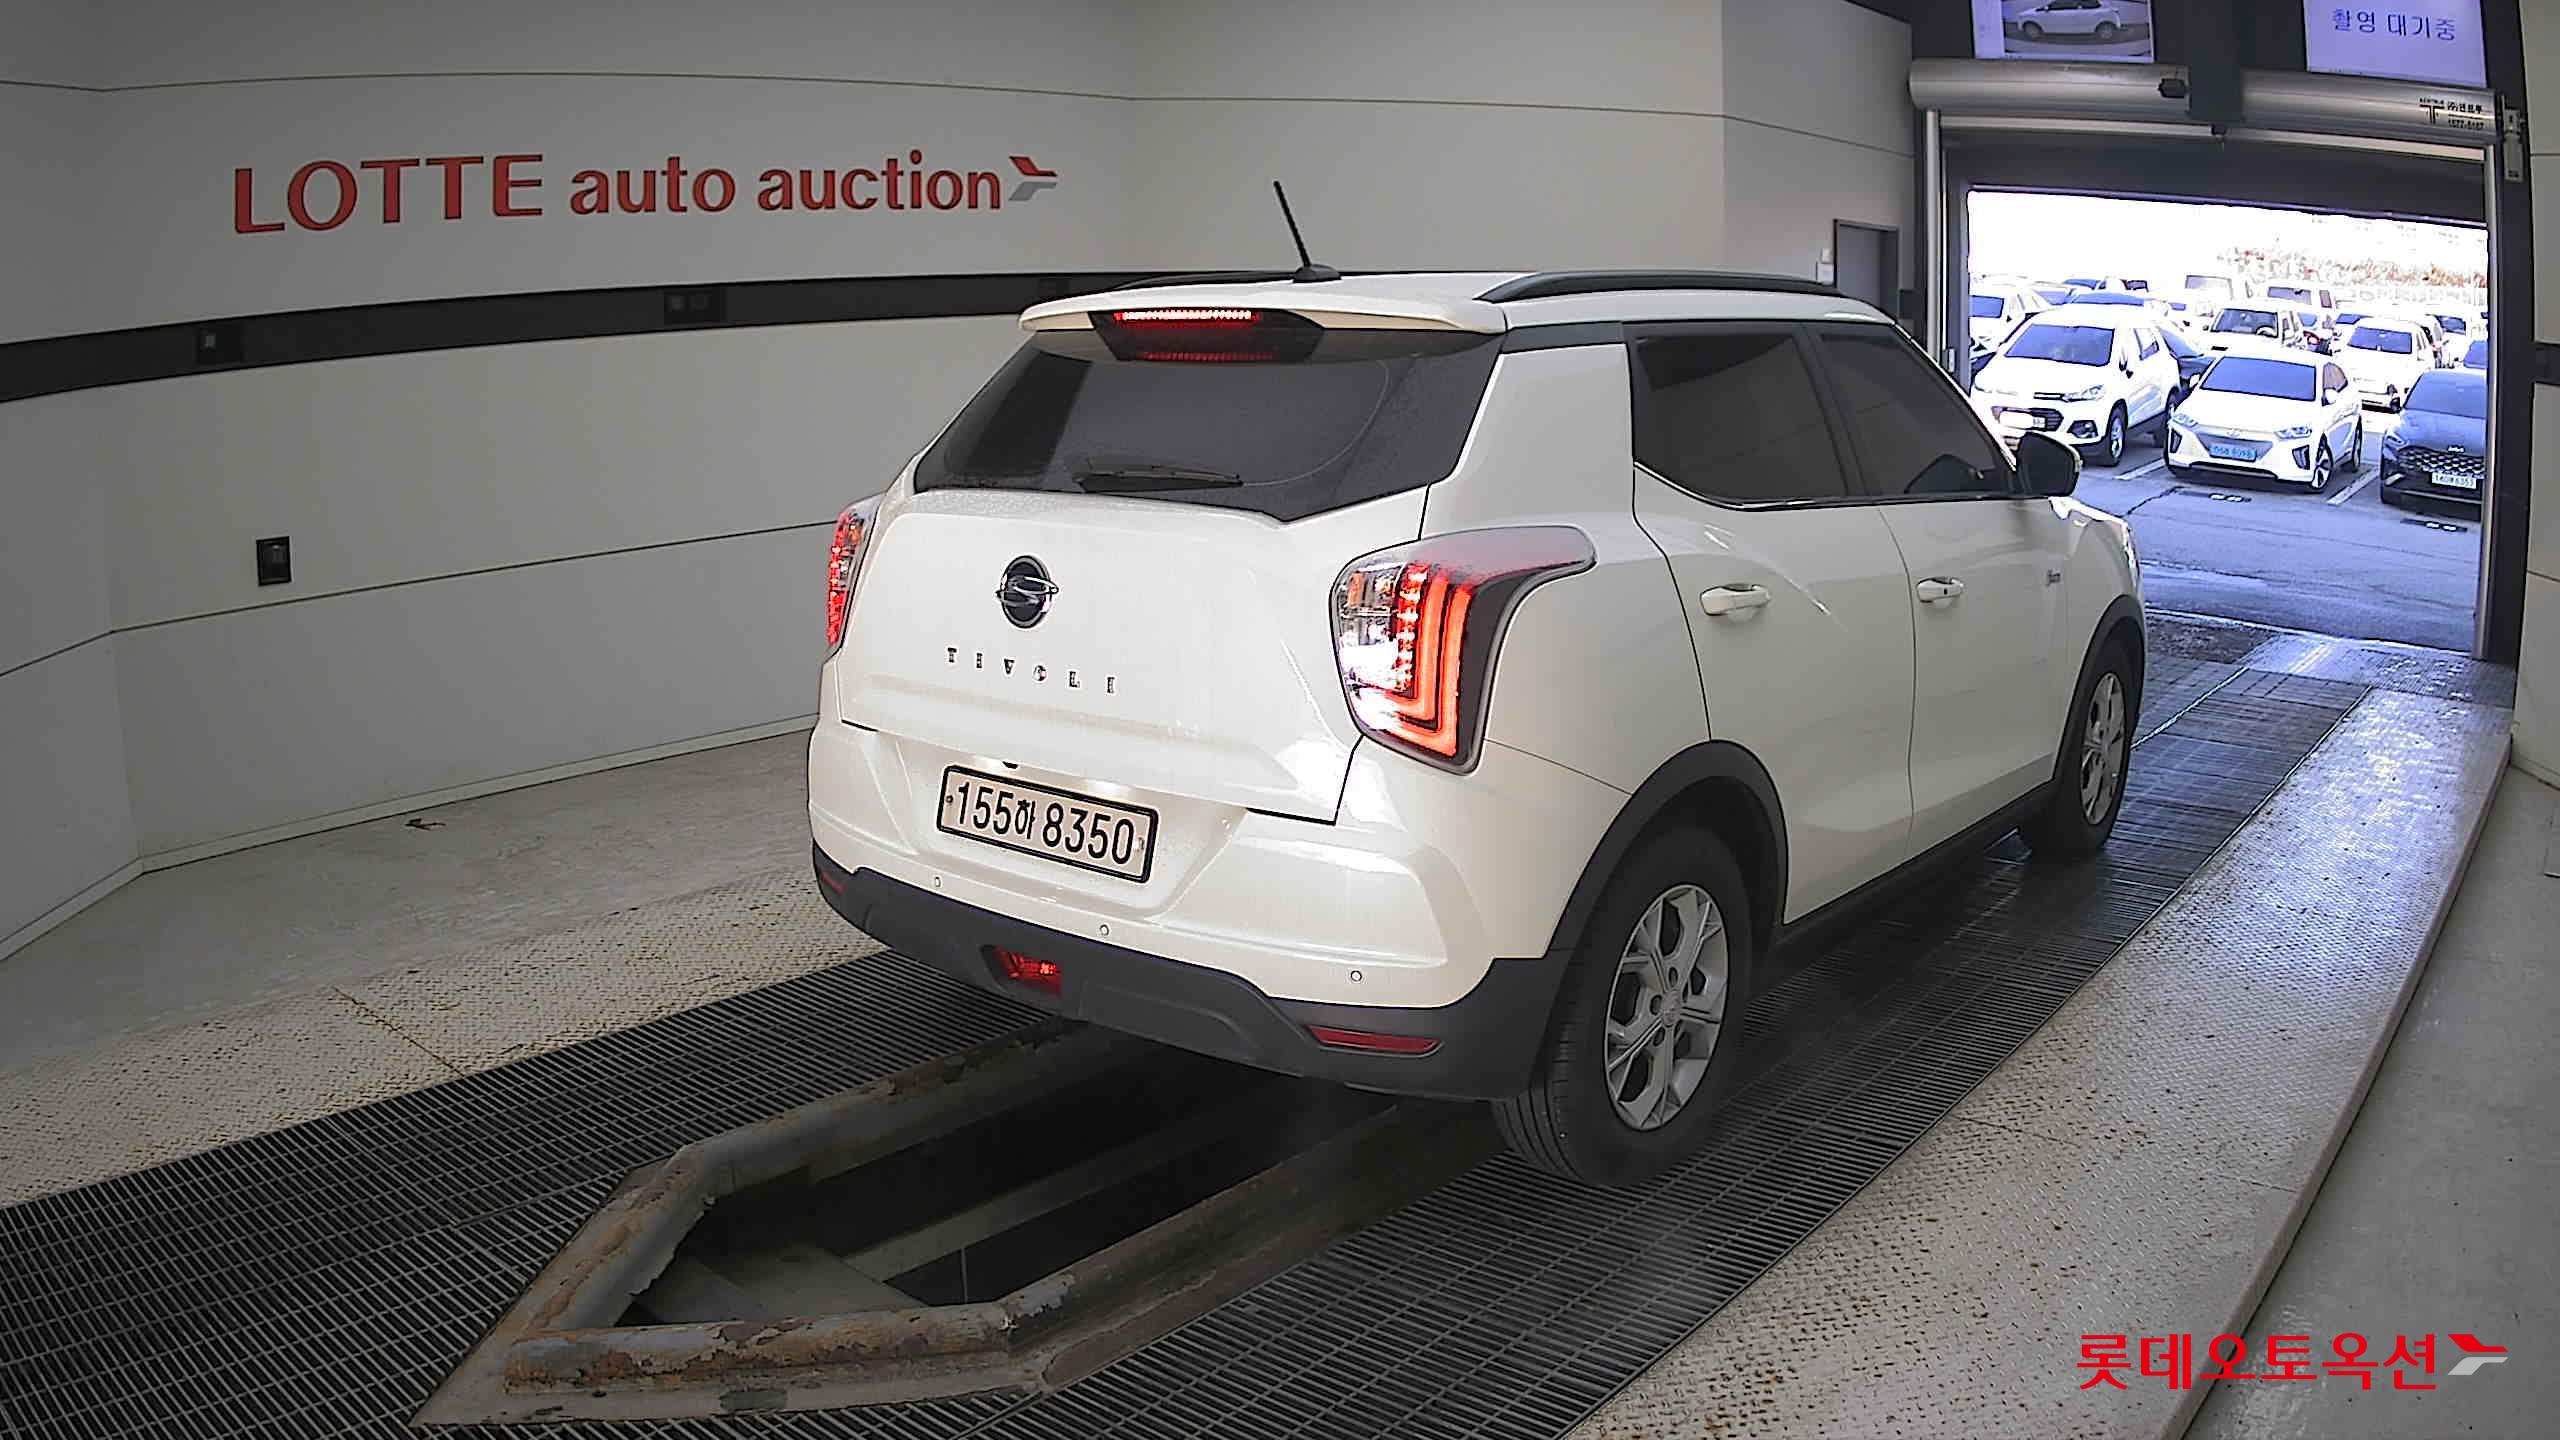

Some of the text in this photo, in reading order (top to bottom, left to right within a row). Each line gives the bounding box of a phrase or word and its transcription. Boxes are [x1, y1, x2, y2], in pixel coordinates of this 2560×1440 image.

[2333, 9, 2455, 41] 촬영 대기중
[235, 151, 1001, 233] LOTTE auto auction
[946, 646, 1116, 694] TIVOLI
